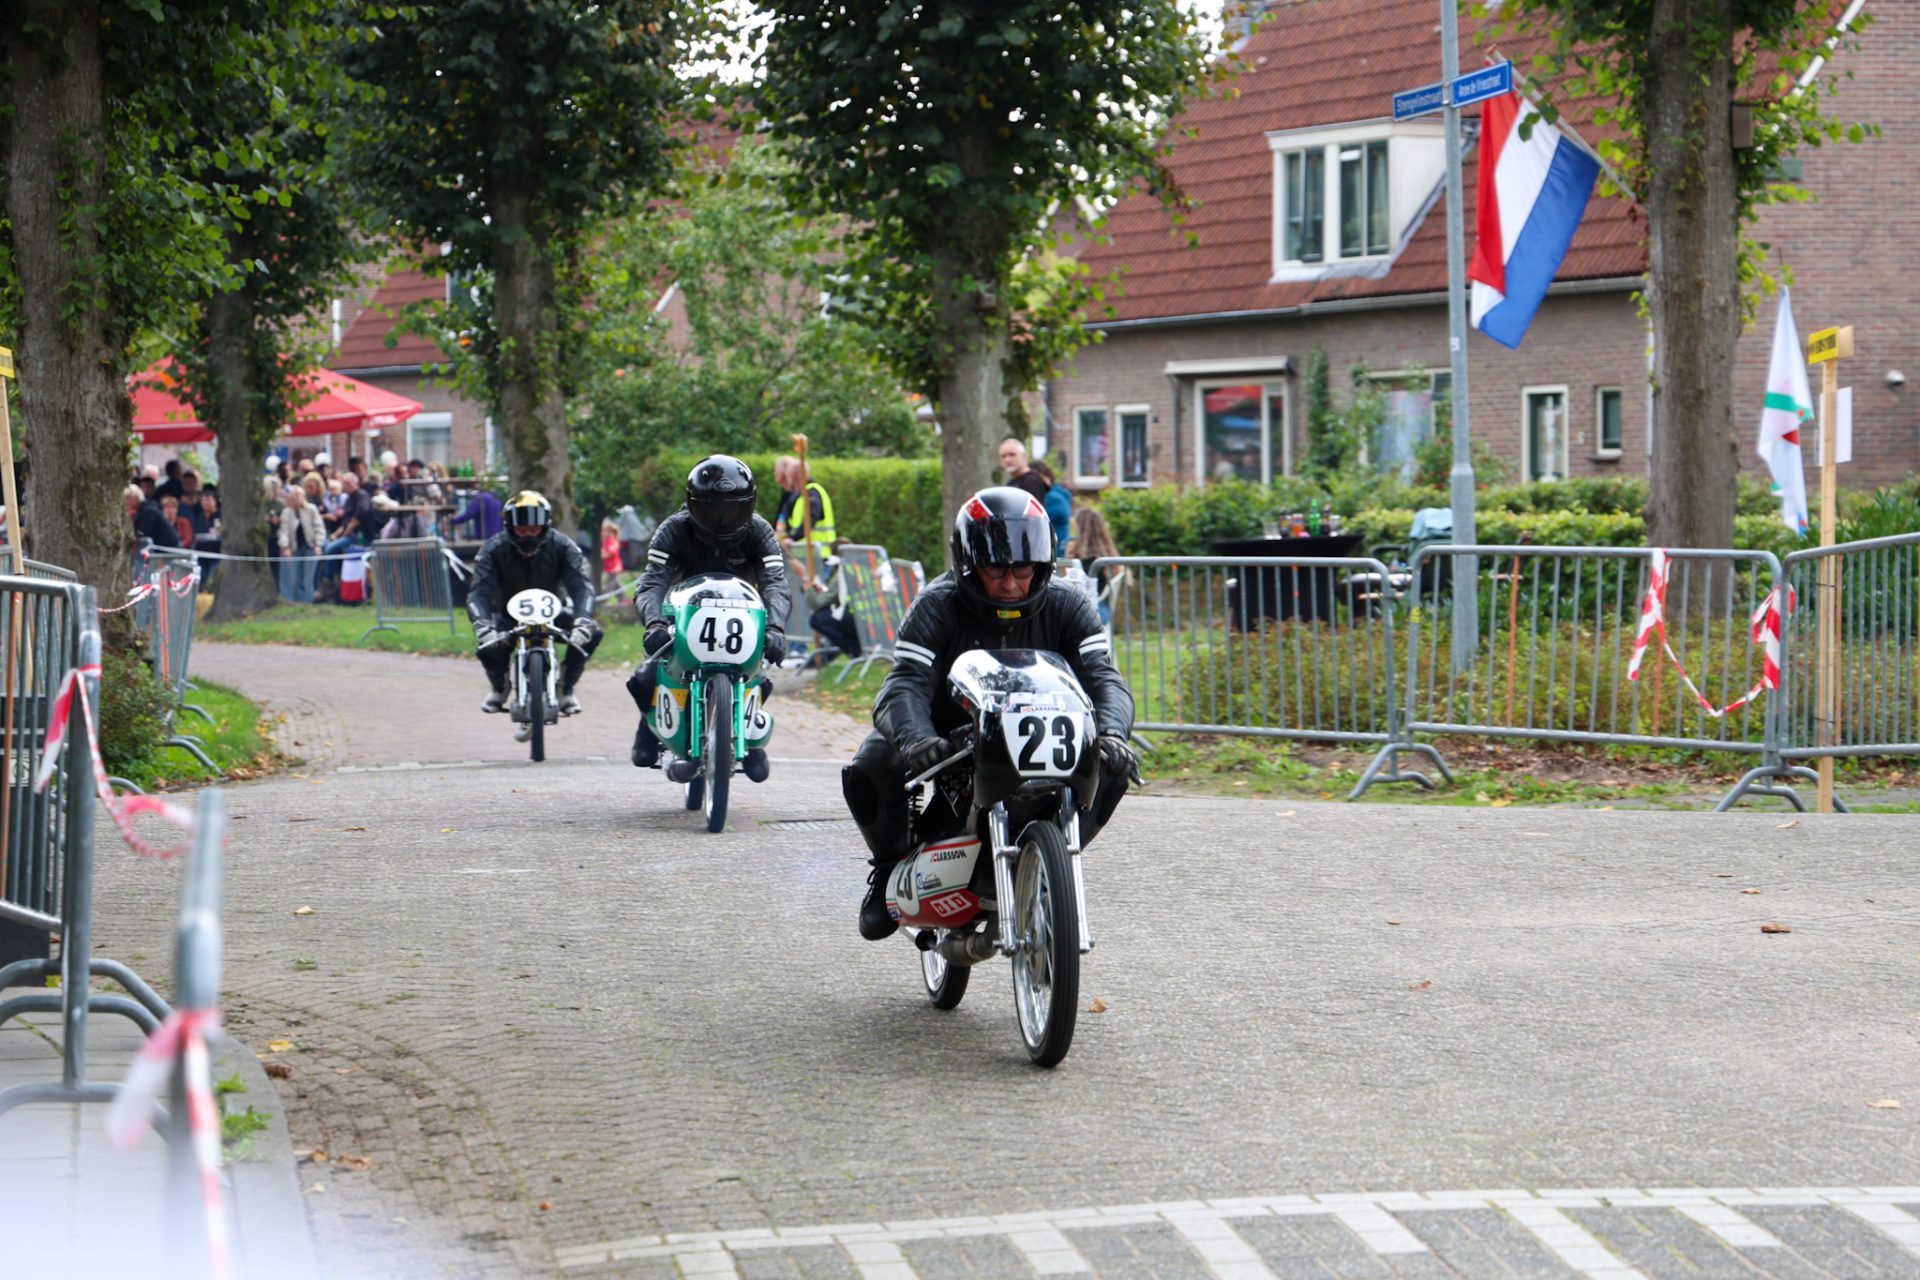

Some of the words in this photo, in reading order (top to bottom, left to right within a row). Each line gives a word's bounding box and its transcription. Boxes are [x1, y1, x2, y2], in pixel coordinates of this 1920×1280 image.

[519, 595, 554, 618] 53
[699, 617, 744, 655] 48
[1018, 715, 1076, 771] 23
[936, 849, 967, 862] LARSSON
